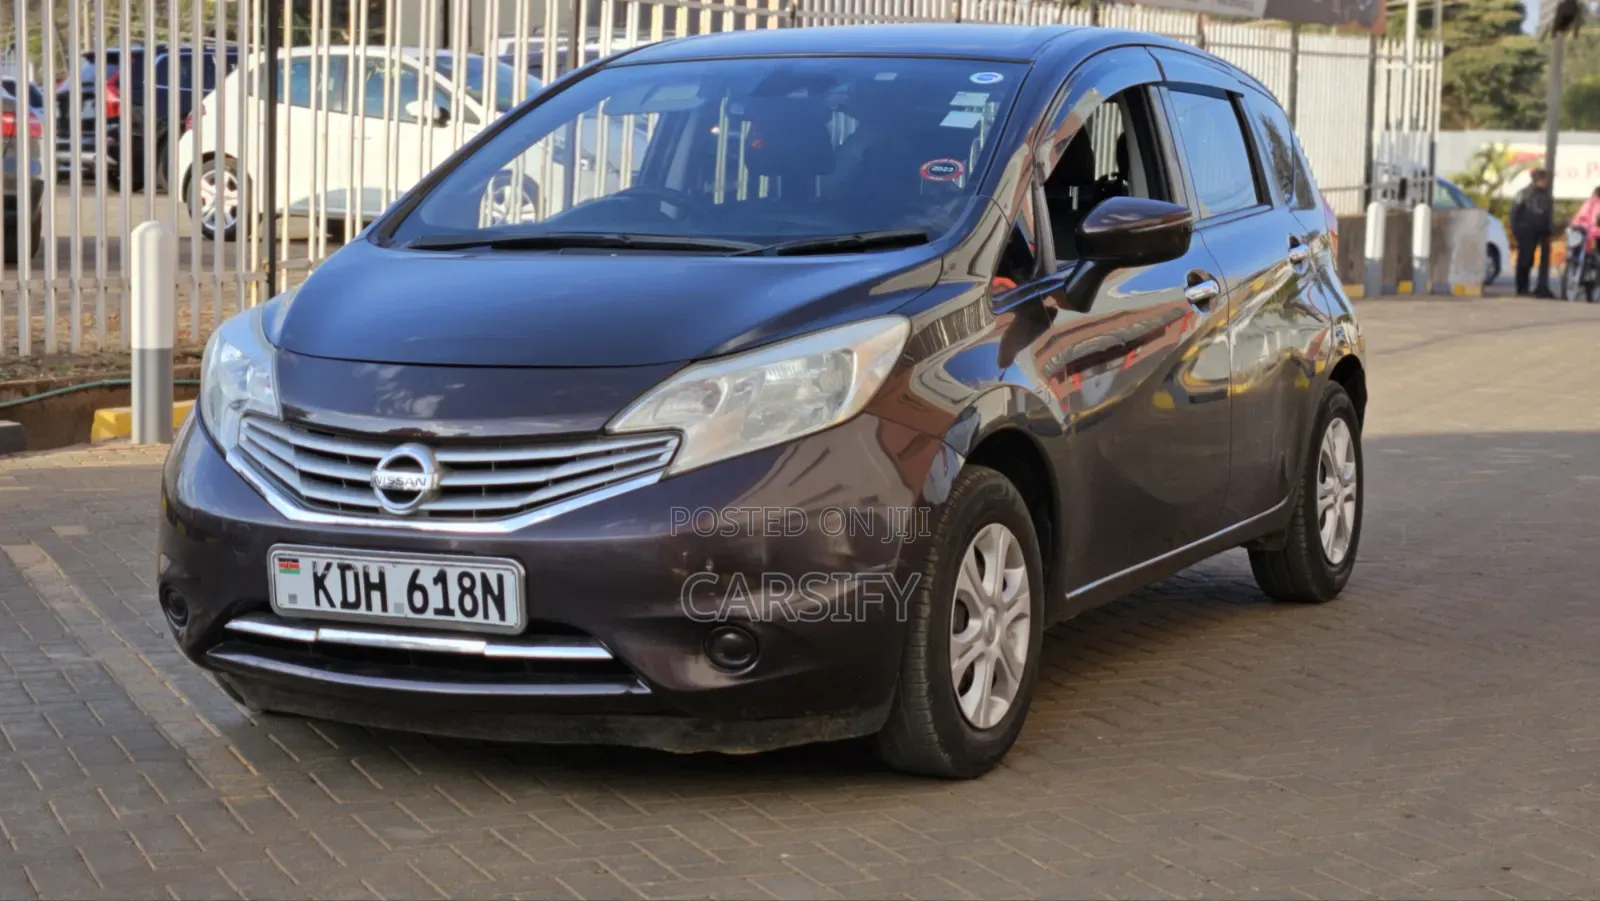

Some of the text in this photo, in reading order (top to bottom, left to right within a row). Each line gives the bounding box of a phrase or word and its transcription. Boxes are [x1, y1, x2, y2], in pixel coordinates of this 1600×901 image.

[374, 475, 427, 487] NISSAN
[312, 561, 506, 621] KDH 618N
